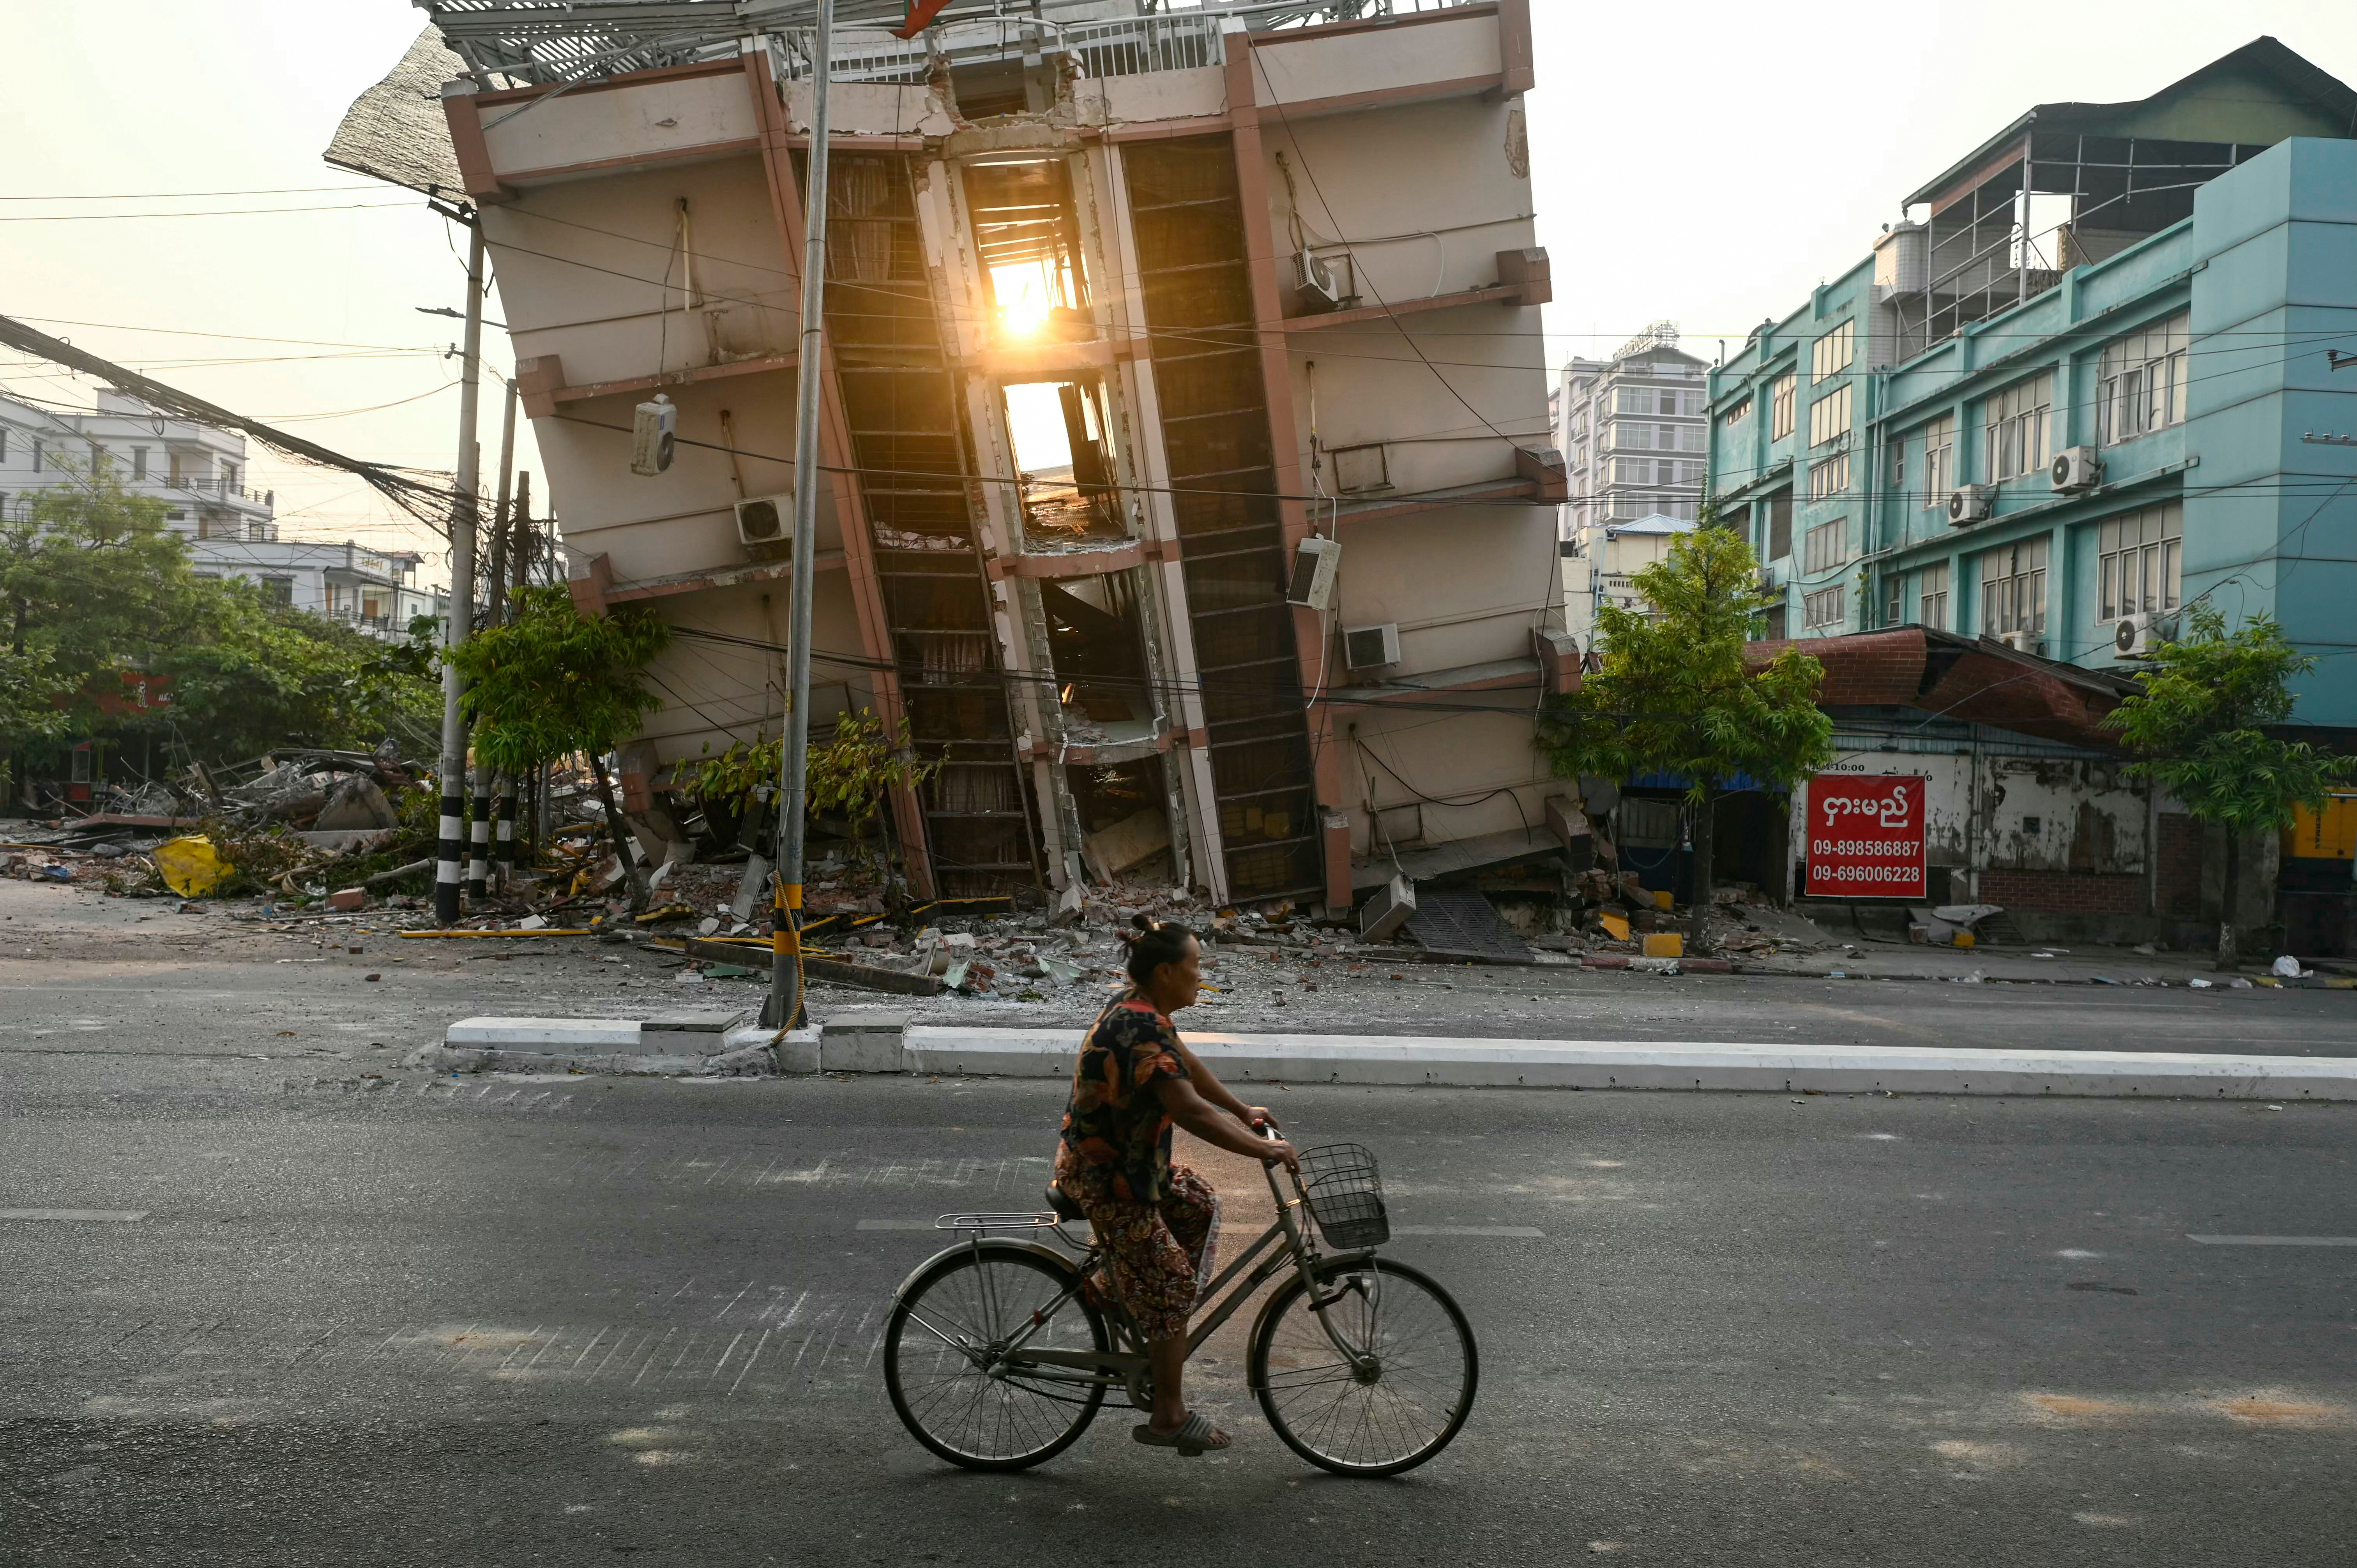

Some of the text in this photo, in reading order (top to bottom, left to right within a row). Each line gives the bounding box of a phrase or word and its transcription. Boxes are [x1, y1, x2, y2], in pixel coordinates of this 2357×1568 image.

[1823, 786, 1908, 827] ငှားမည်
[1814, 839, 1920, 856] 09-898586887
[1813, 865, 1920, 882] 09-696006228
